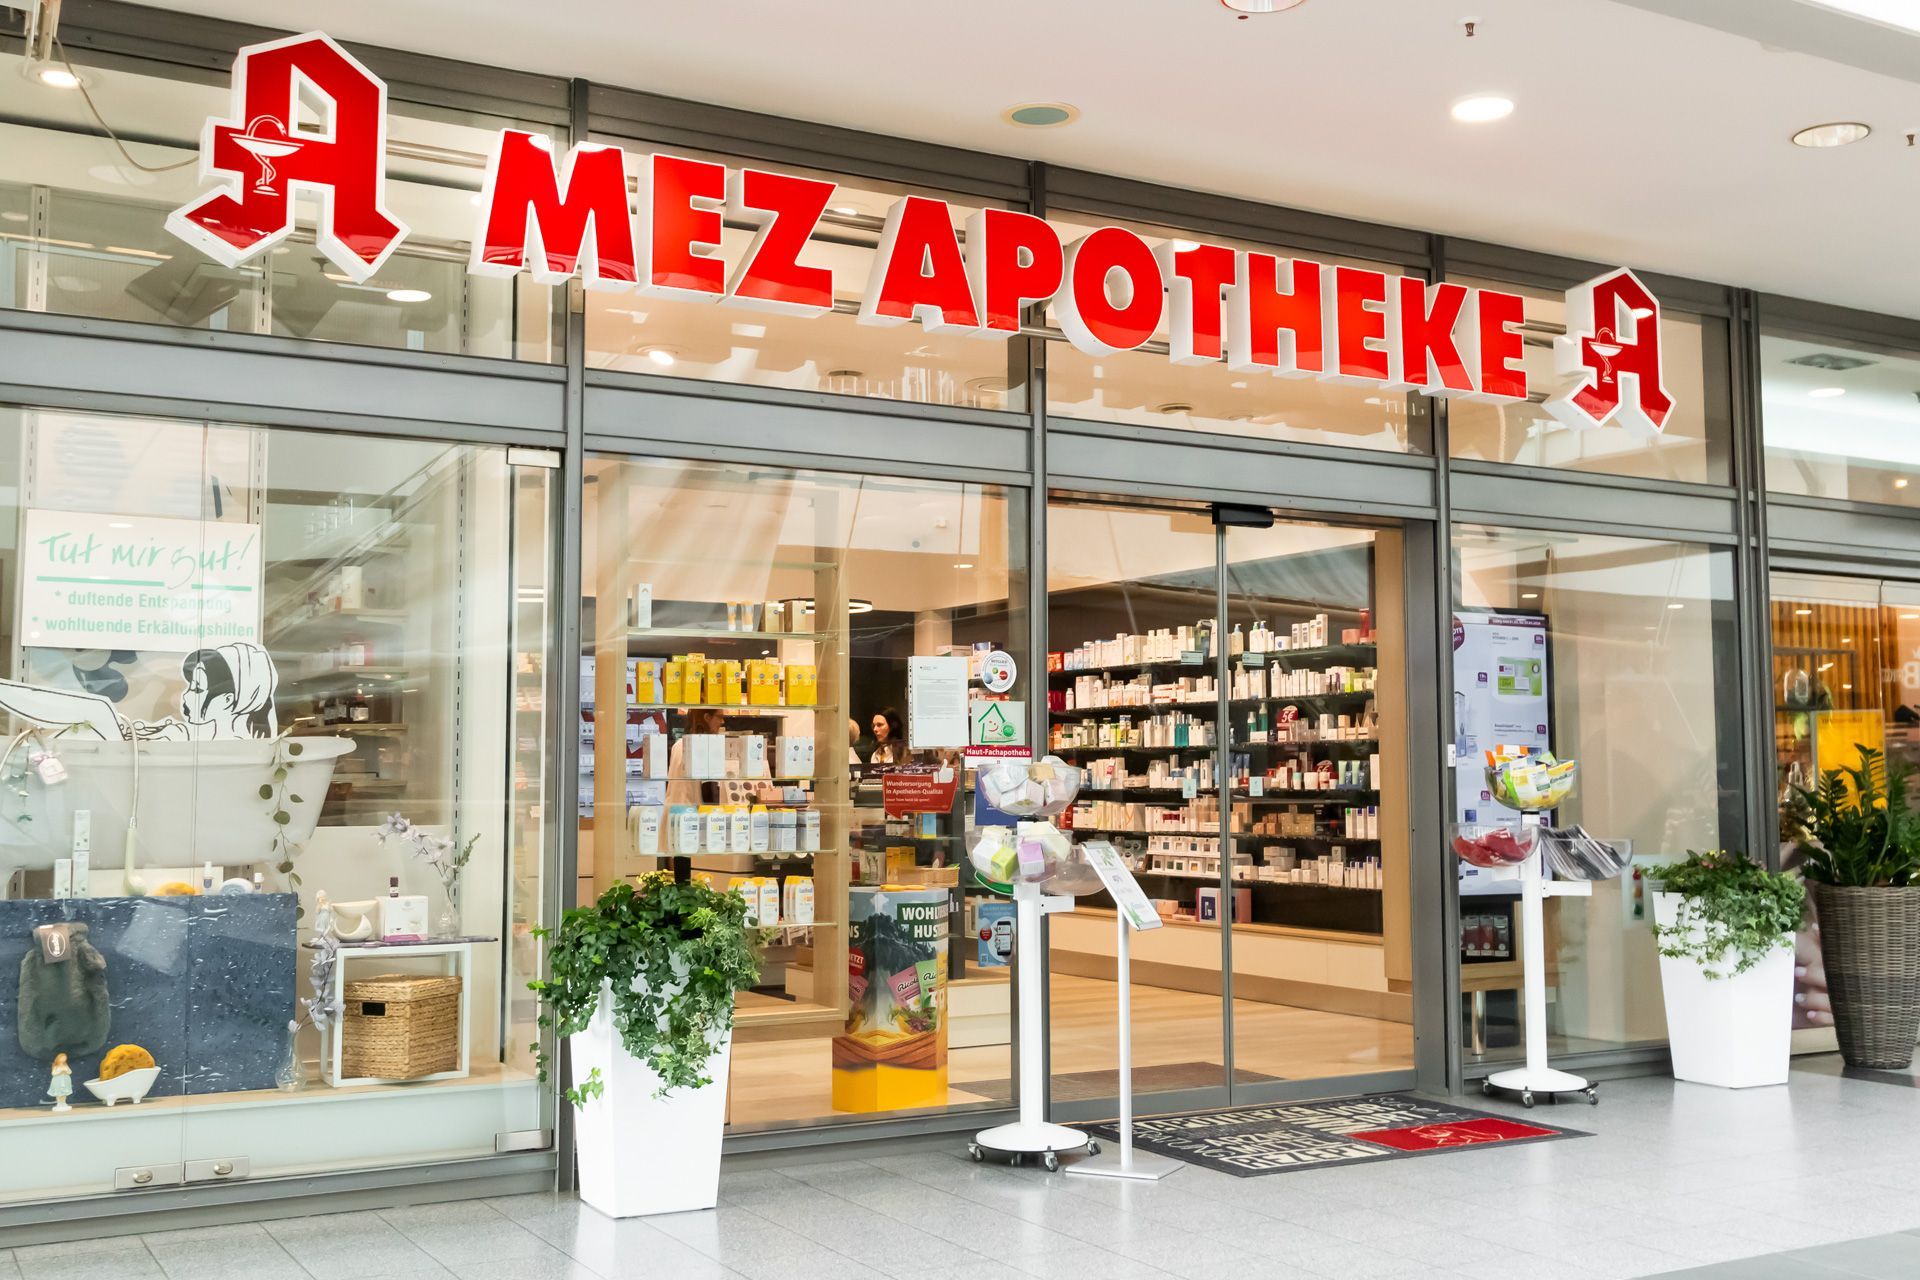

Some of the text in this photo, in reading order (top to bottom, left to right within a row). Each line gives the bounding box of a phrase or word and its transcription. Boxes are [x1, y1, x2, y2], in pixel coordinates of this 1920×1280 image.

[472, 129, 1529, 403] MEZ APOTHEKE
[38, 532, 103, 564] Tut
[111, 538, 166, 568] mir
[68, 591, 232, 613] duftende Entspannung
[45, 619, 254, 638] wohltuende Erkältungshilfen
[966, 747, 1031, 758] Haut-Fachapotheke
[886, 780, 931, 788] Wundversorgung
[1136, 1106, 1315, 1132] APOTHEKE
[1320, 1103, 1397, 1117] VOR
[1363, 1110, 1427, 1124] ORT
[1203, 1129, 1315, 1147] ARZNEI
[1226, 1137, 1344, 1155] MITTEL
[1230, 1144, 1387, 1168] REZEPT
